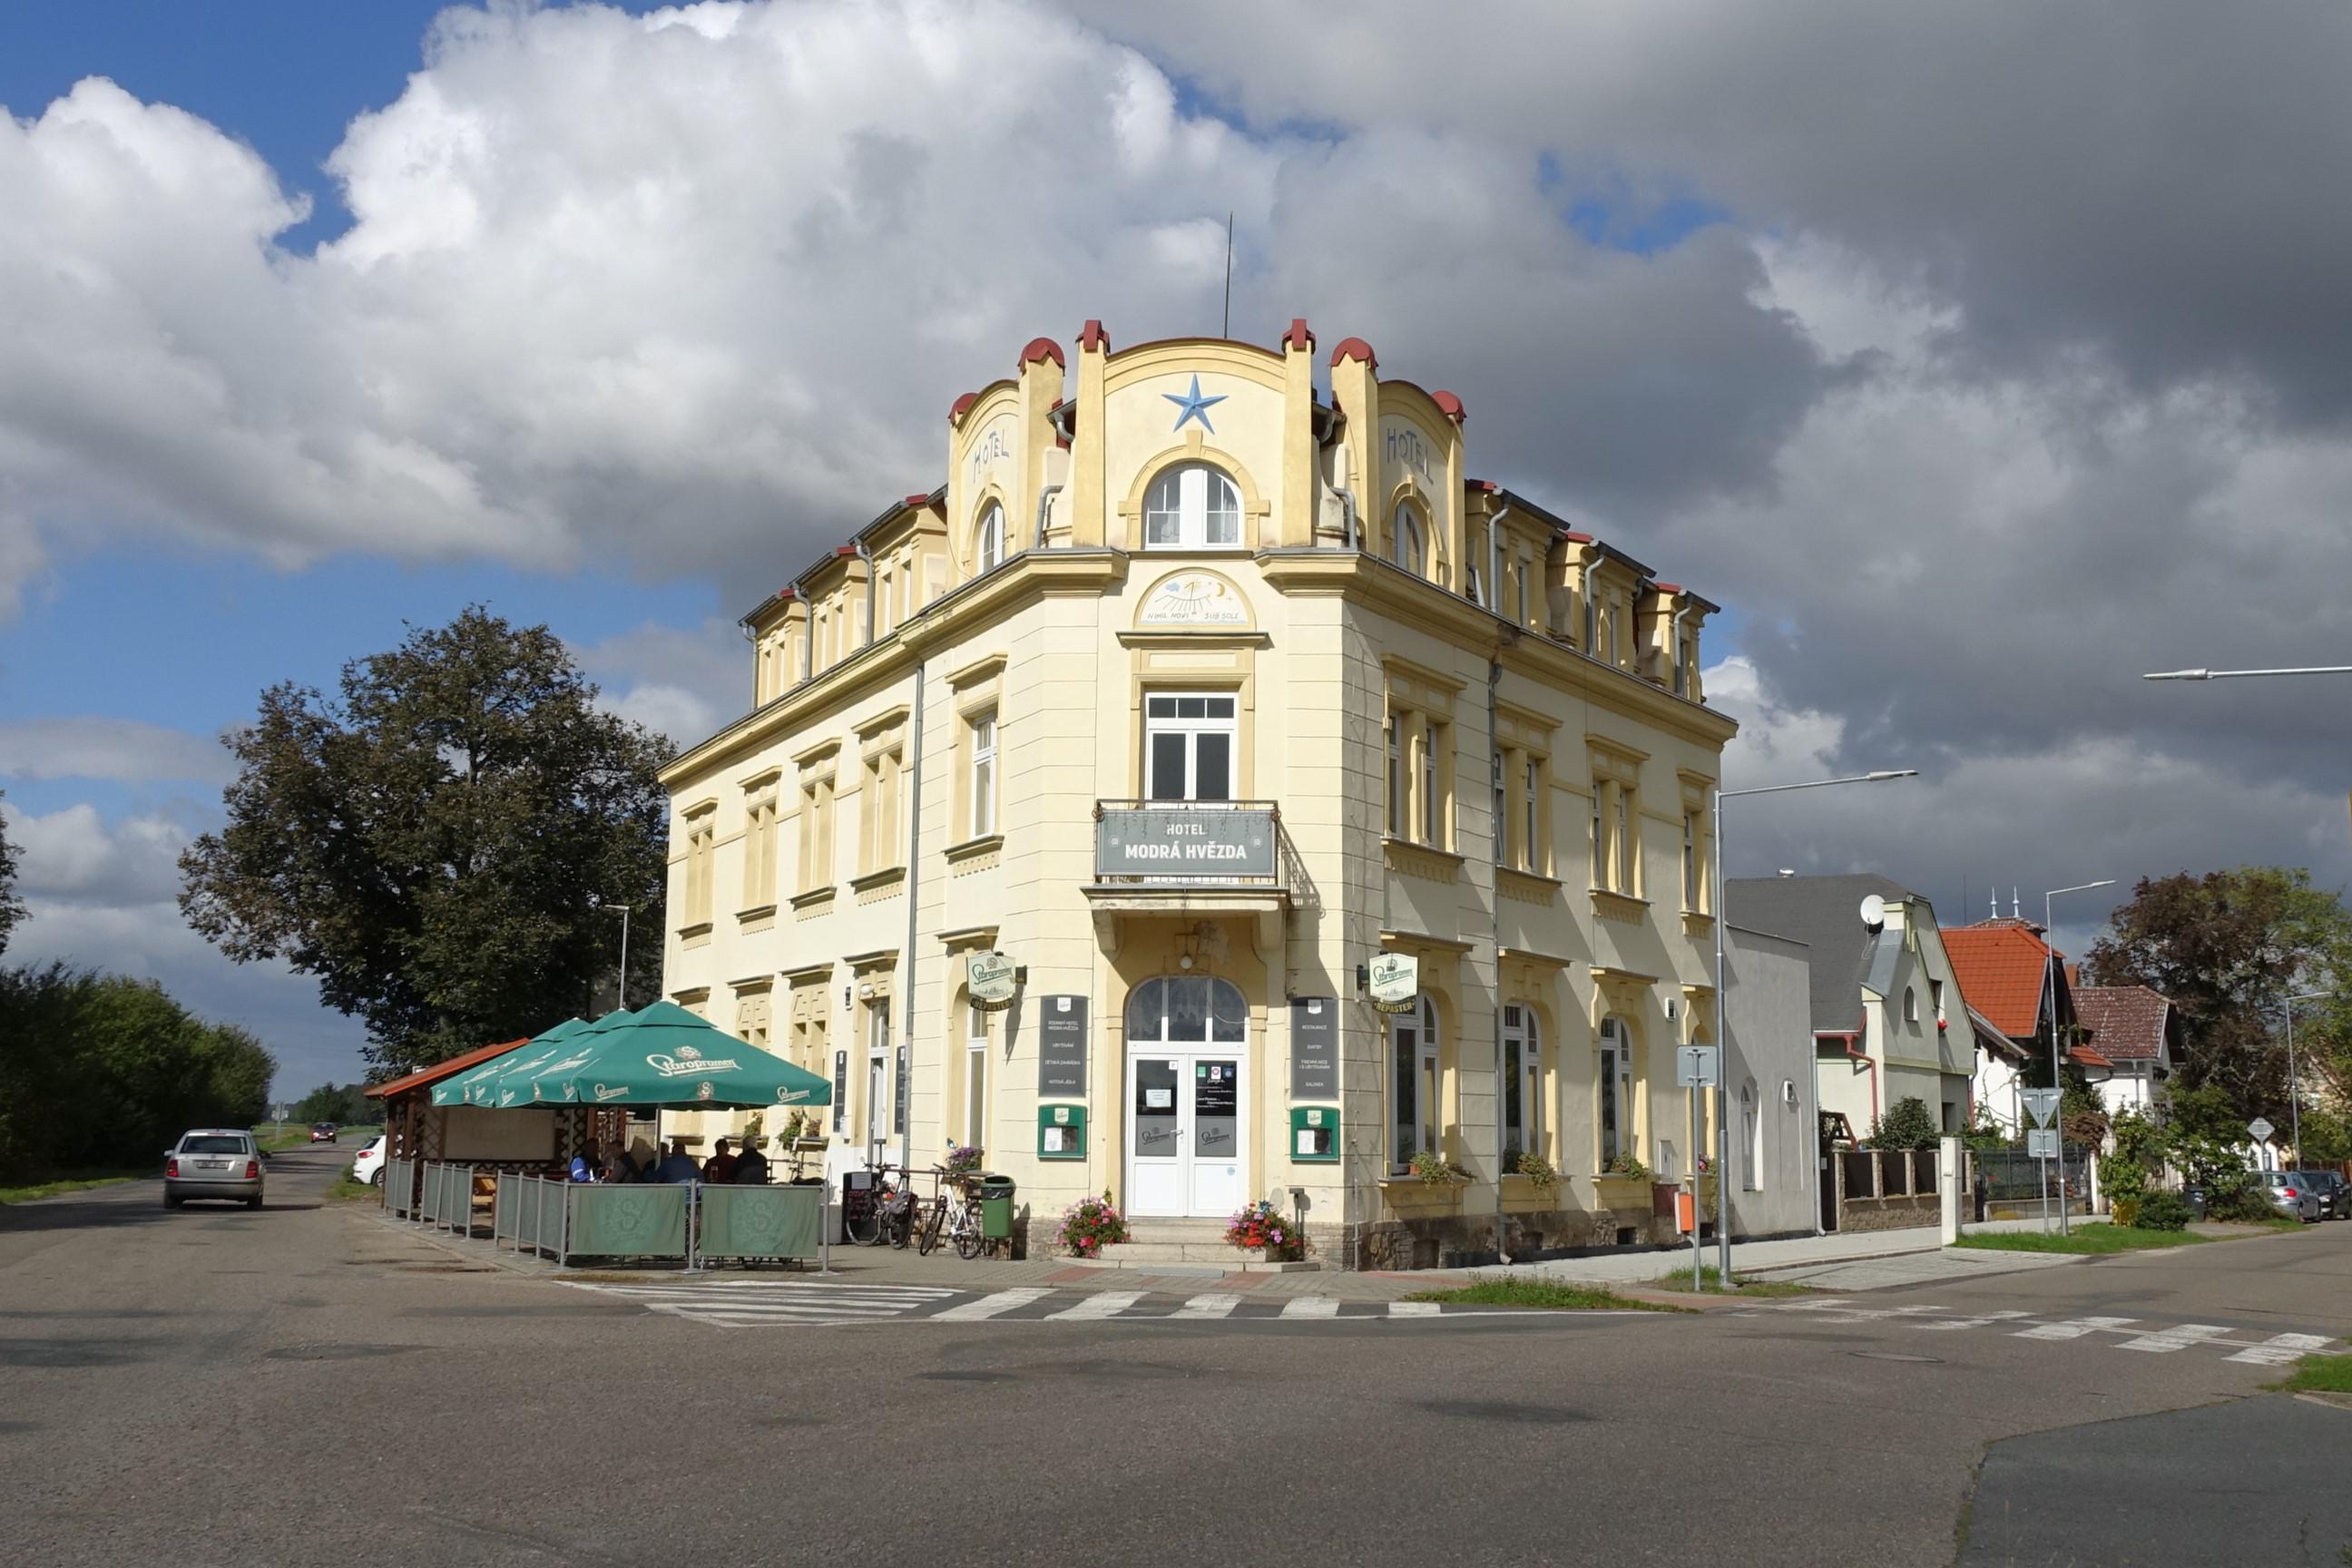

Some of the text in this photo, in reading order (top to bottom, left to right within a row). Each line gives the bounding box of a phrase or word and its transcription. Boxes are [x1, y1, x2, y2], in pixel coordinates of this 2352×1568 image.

[973, 428, 1010, 484] HOTEL
[1387, 427, 1434, 485] HOTEL
[1166, 824, 1206, 836] HOTEL
[1125, 840, 1248, 859] MODRÁ HVĚZDA
[646, 1054, 743, 1077] Staropramen
